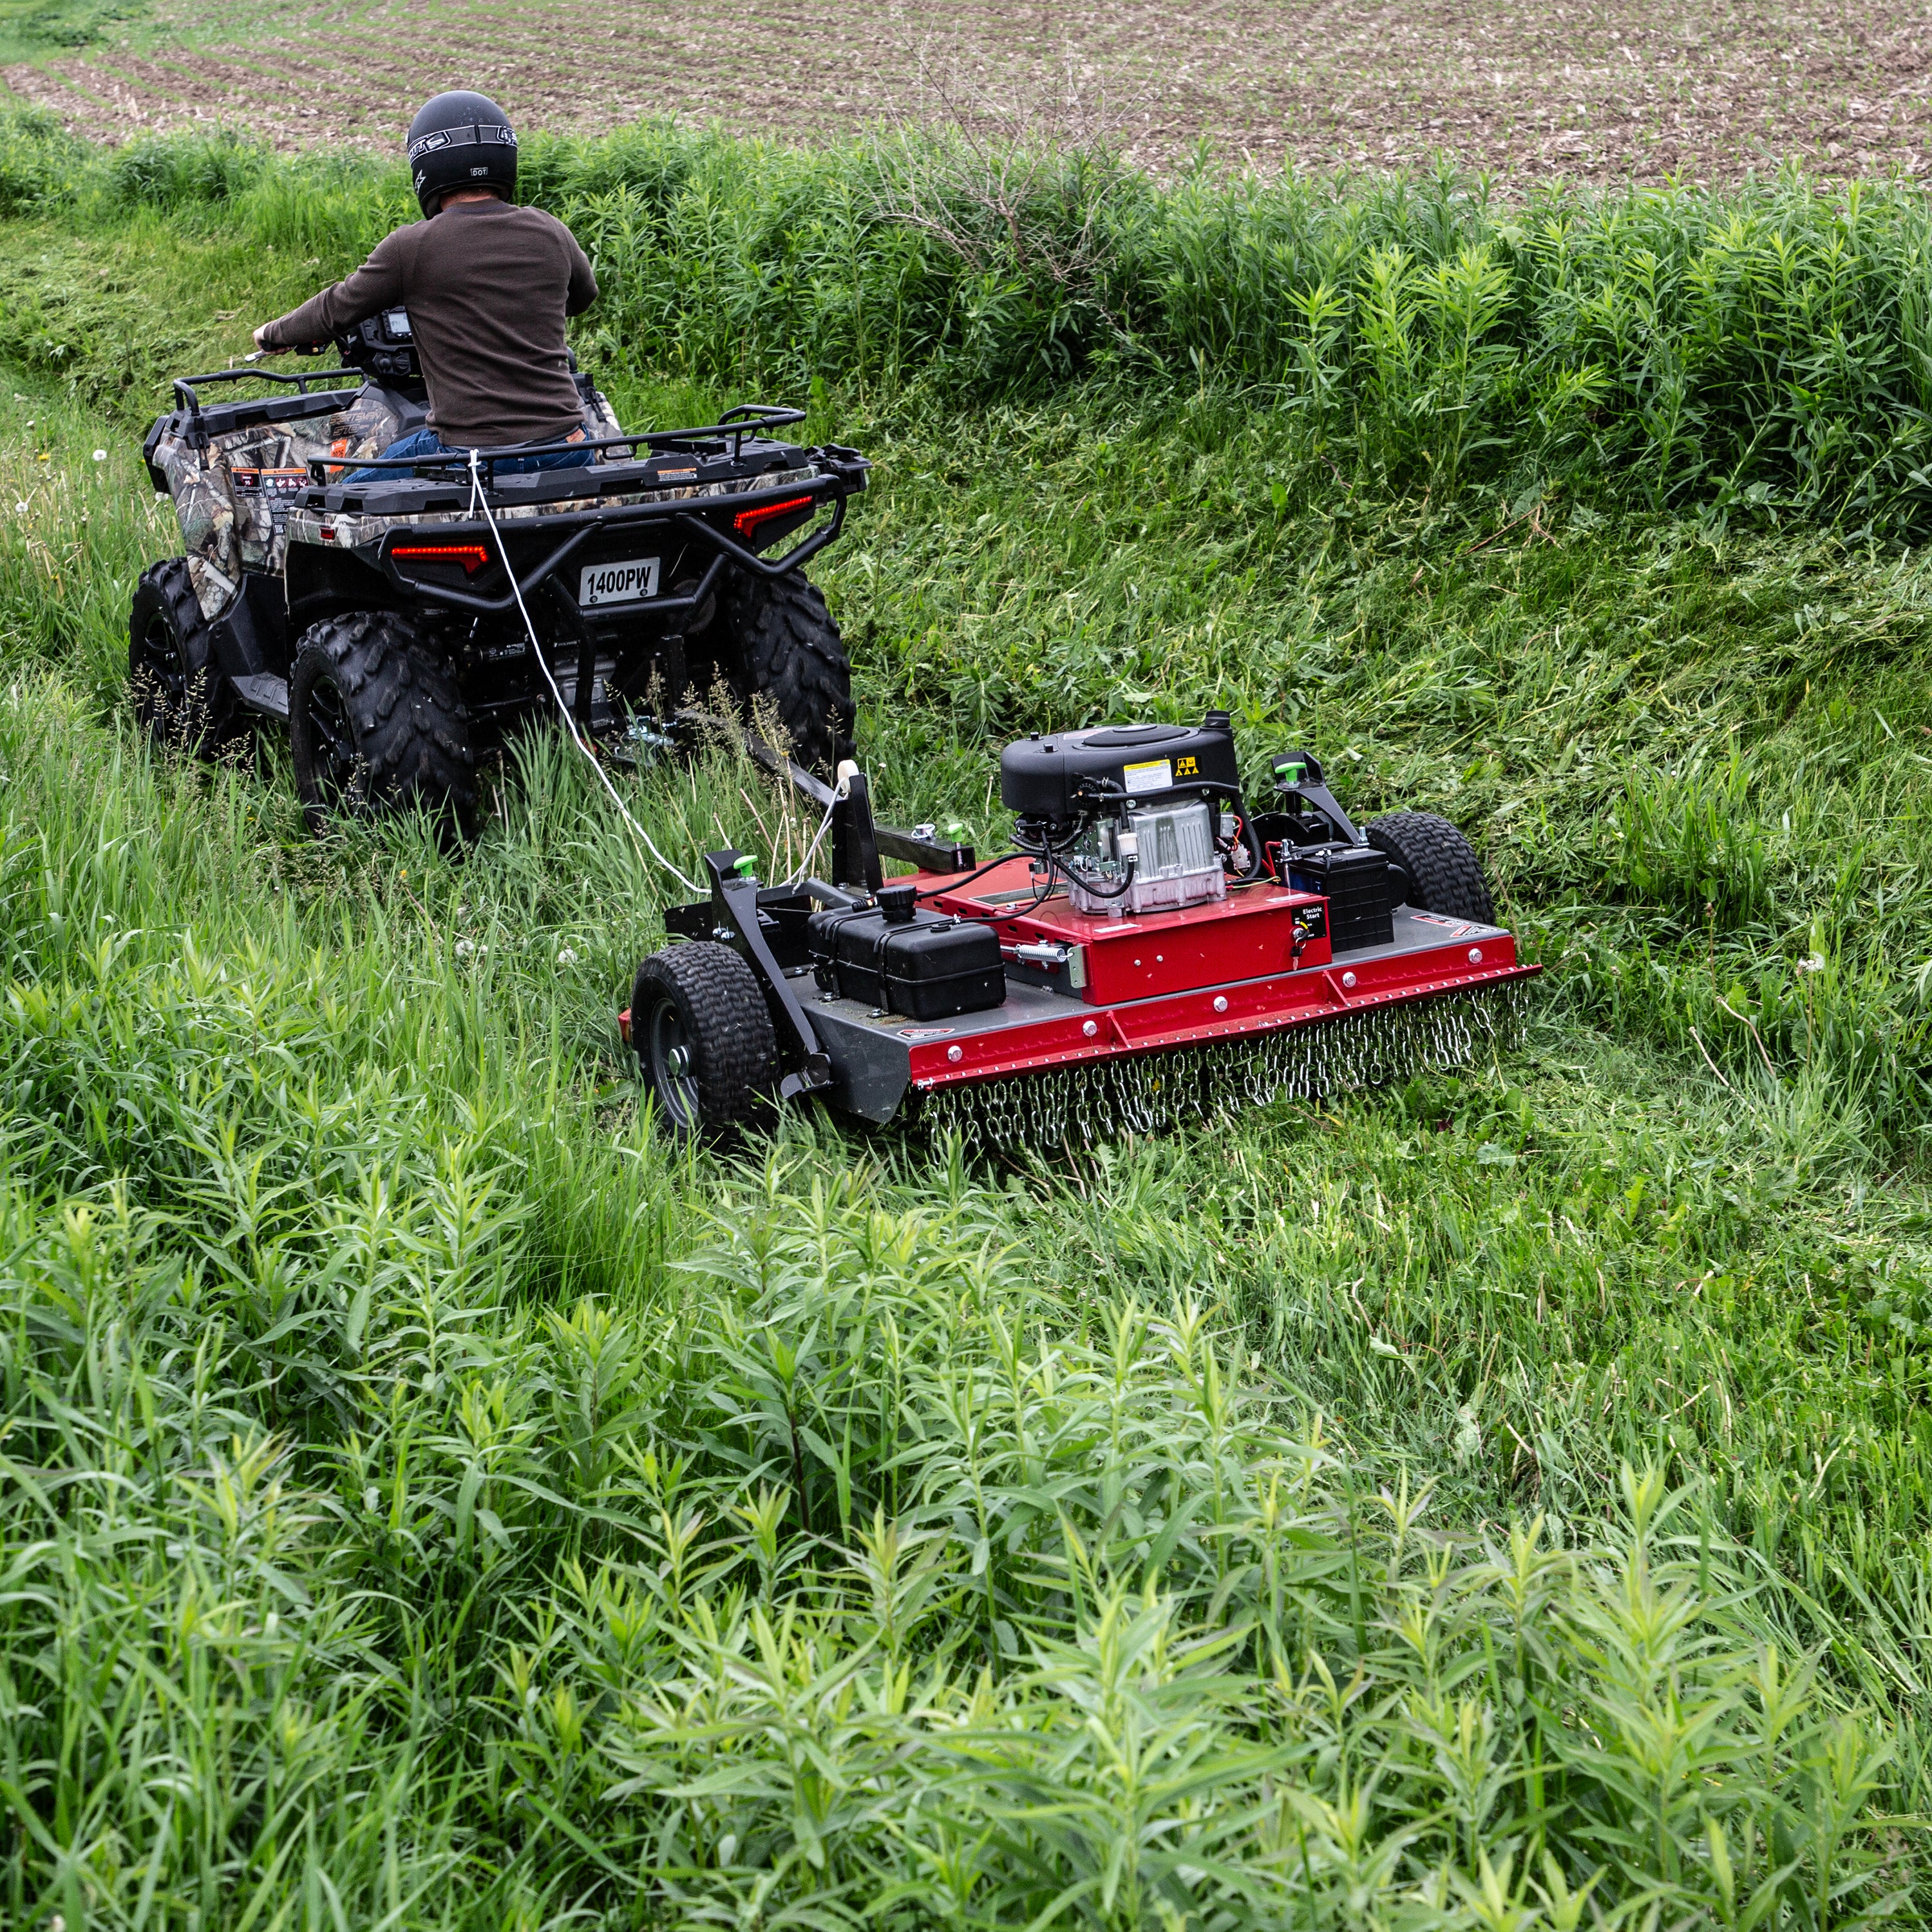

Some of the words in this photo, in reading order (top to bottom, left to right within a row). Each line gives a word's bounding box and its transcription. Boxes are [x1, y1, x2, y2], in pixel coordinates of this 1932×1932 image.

[329, 412, 383, 425] SPORTSMAN
[333, 424, 361, 437] 570
[587, 566, 651, 595] 1400PW
[1302, 906, 1322, 914] Electric
